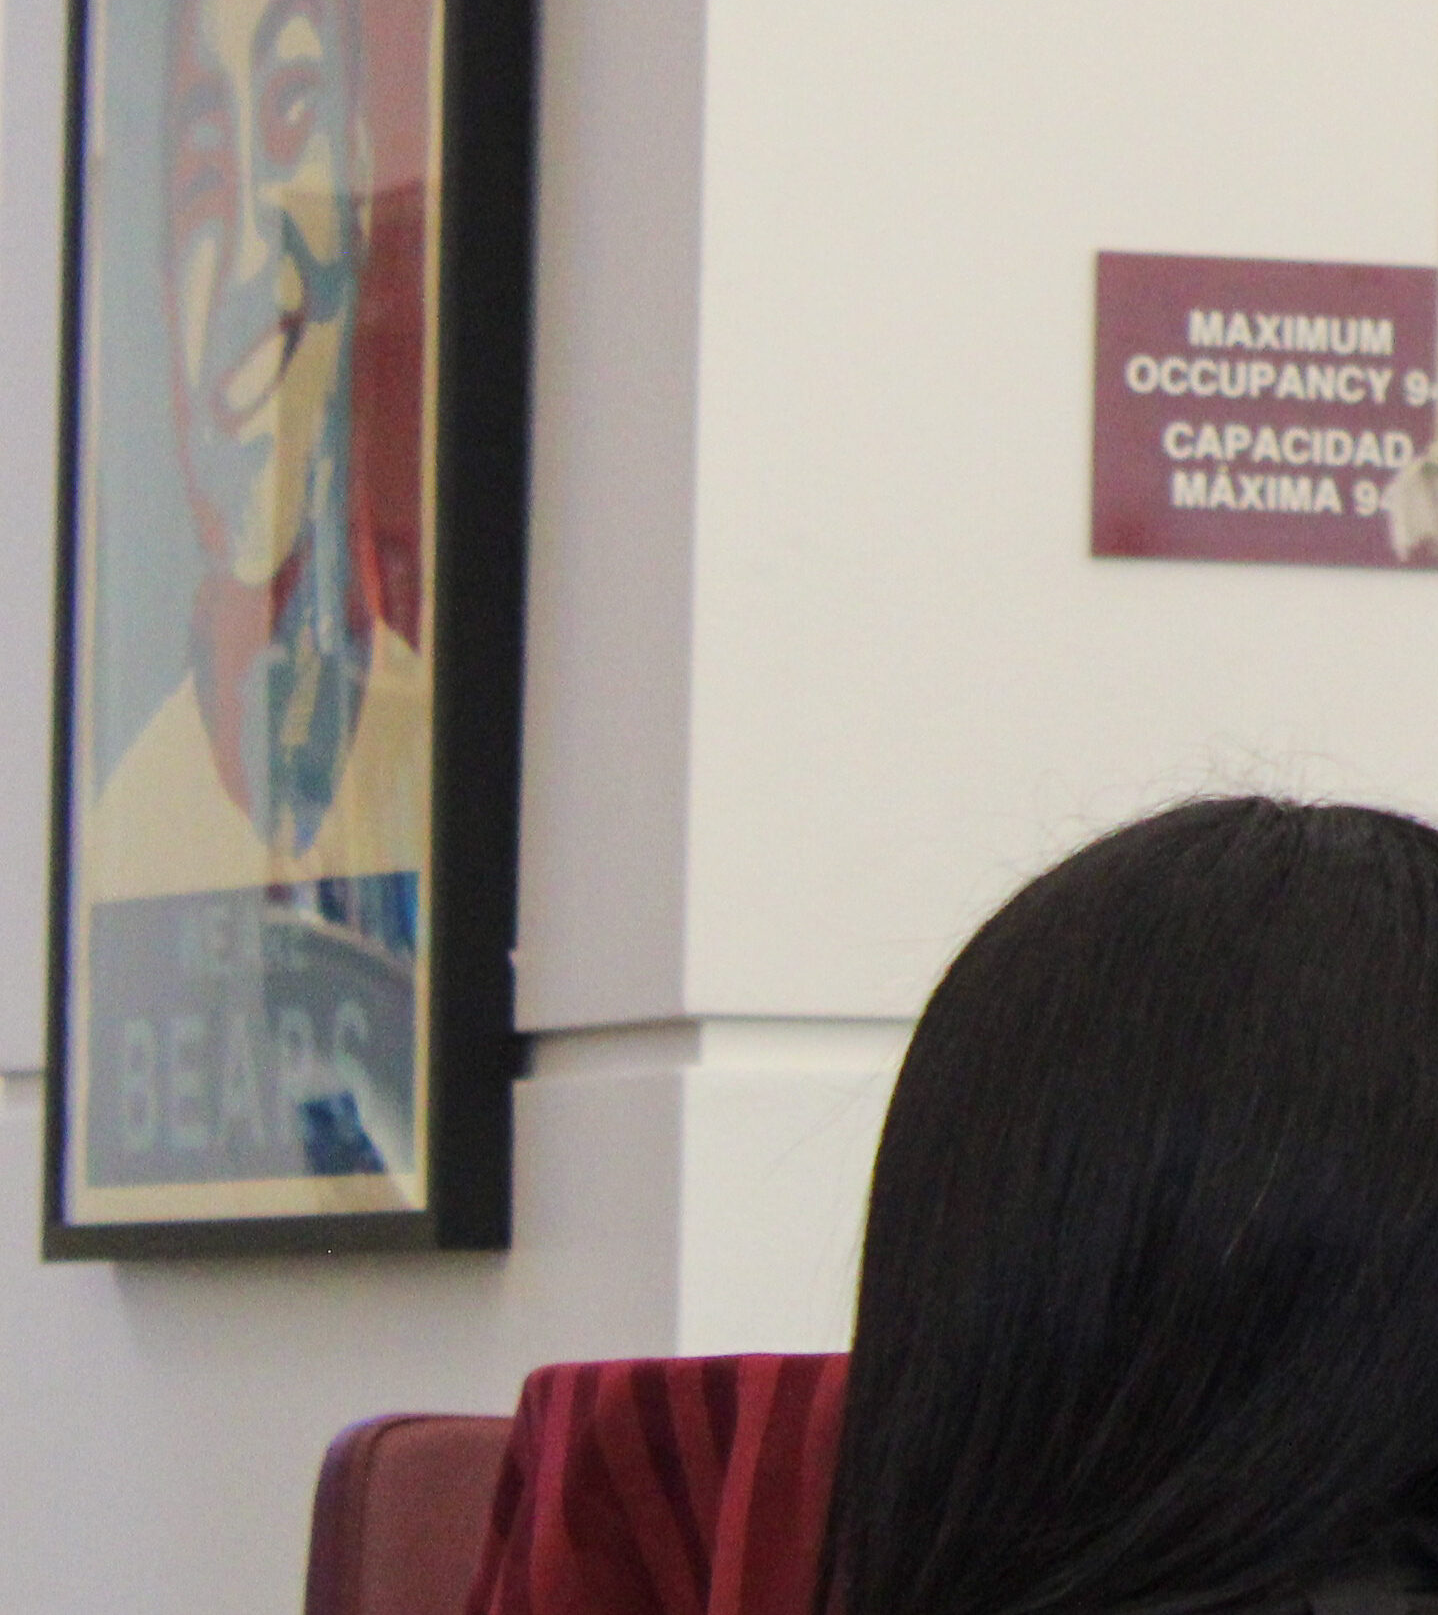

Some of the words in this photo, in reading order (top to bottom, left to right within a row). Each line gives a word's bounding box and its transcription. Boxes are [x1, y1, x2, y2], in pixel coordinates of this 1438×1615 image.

[1187, 309, 1395, 356] MAXIMUM
[1124, 354, 1394, 403] OCCUPANCY
[1162, 421, 1414, 468] CAPACIDAD
[1171, 465, 1343, 514] MÁXIMA
